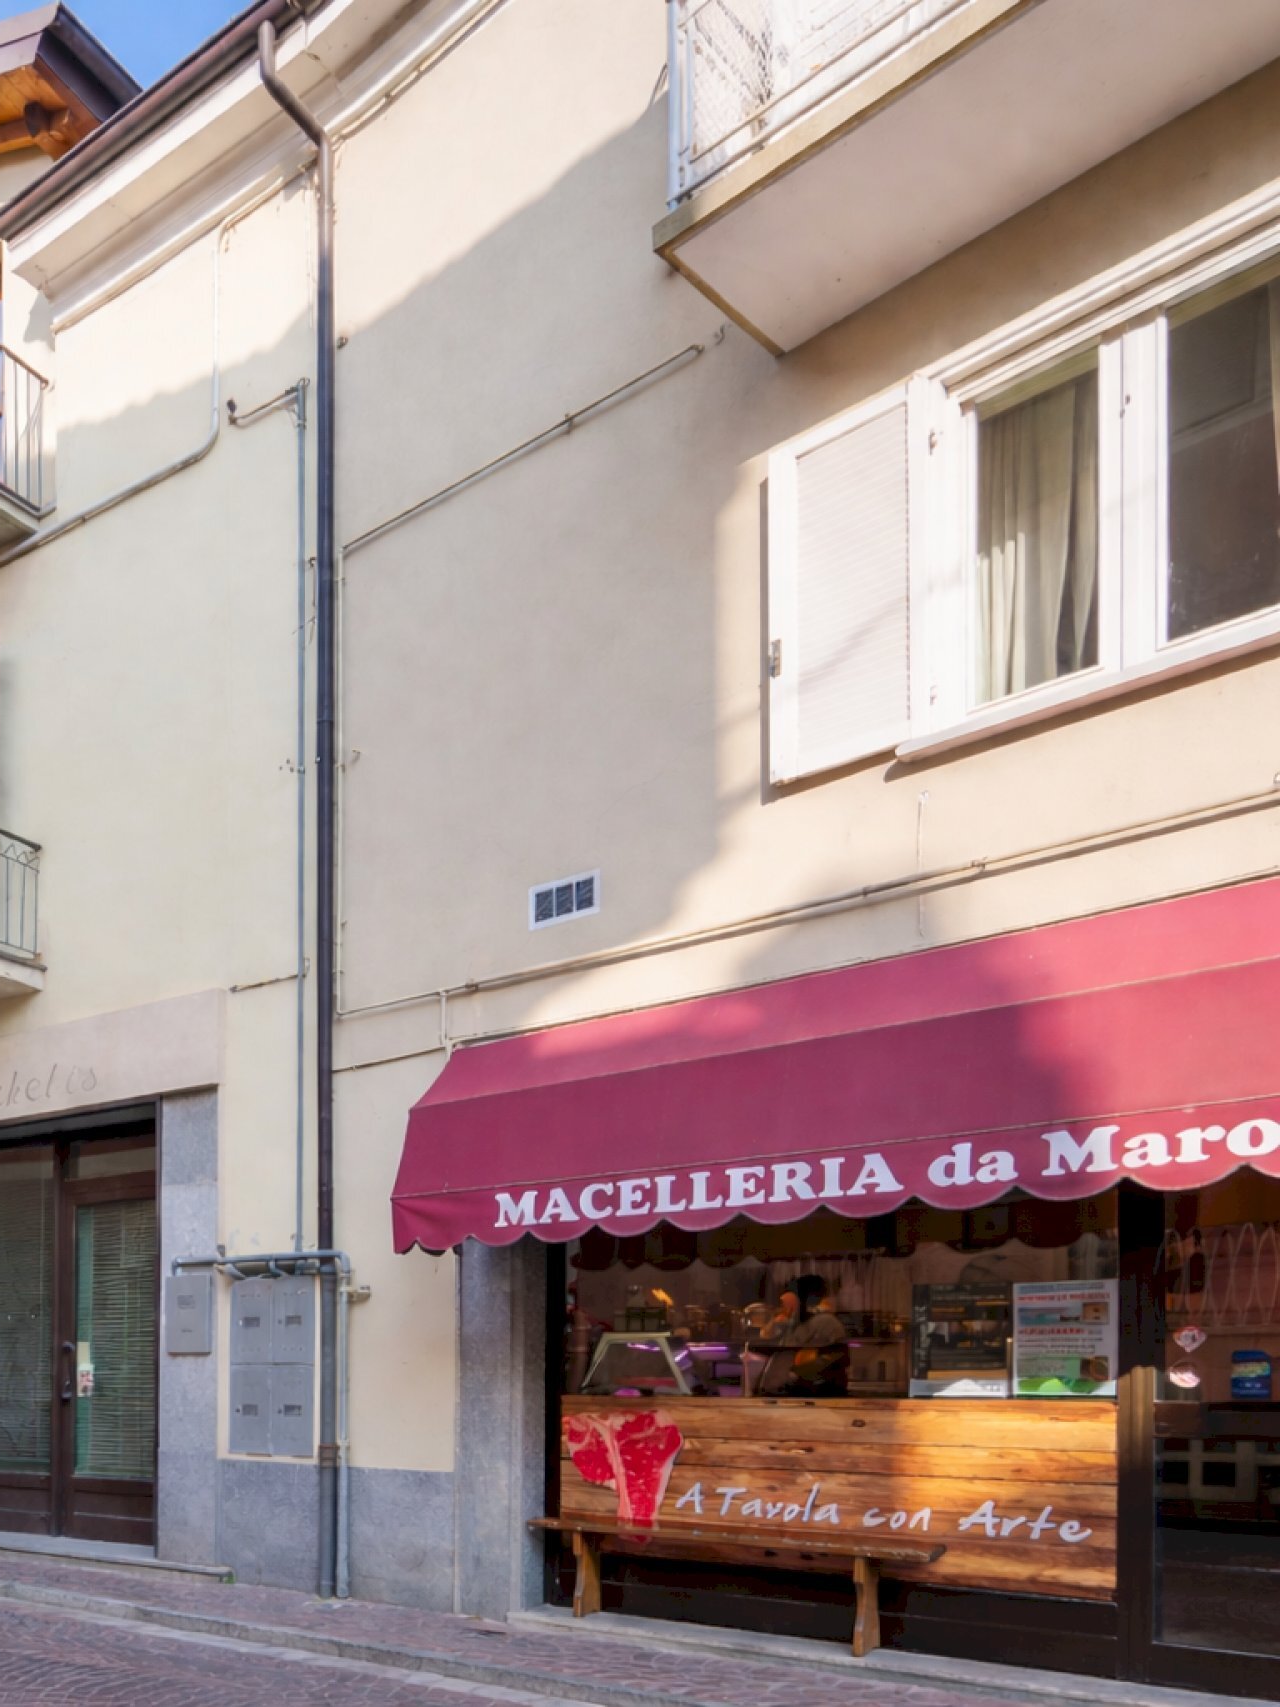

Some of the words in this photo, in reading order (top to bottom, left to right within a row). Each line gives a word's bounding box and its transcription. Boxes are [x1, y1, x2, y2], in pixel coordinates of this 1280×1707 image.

[494, 1152, 904, 1228] MACELLERIA
[927, 1143, 1017, 1188] da
[1041, 1117, 1280, 1176] Maro
[675, 1482, 705, 1514] A
[717, 1483, 840, 1525] Tavola
[862, 1505, 932, 1531] con
[958, 1500, 1093, 1543] Arte
